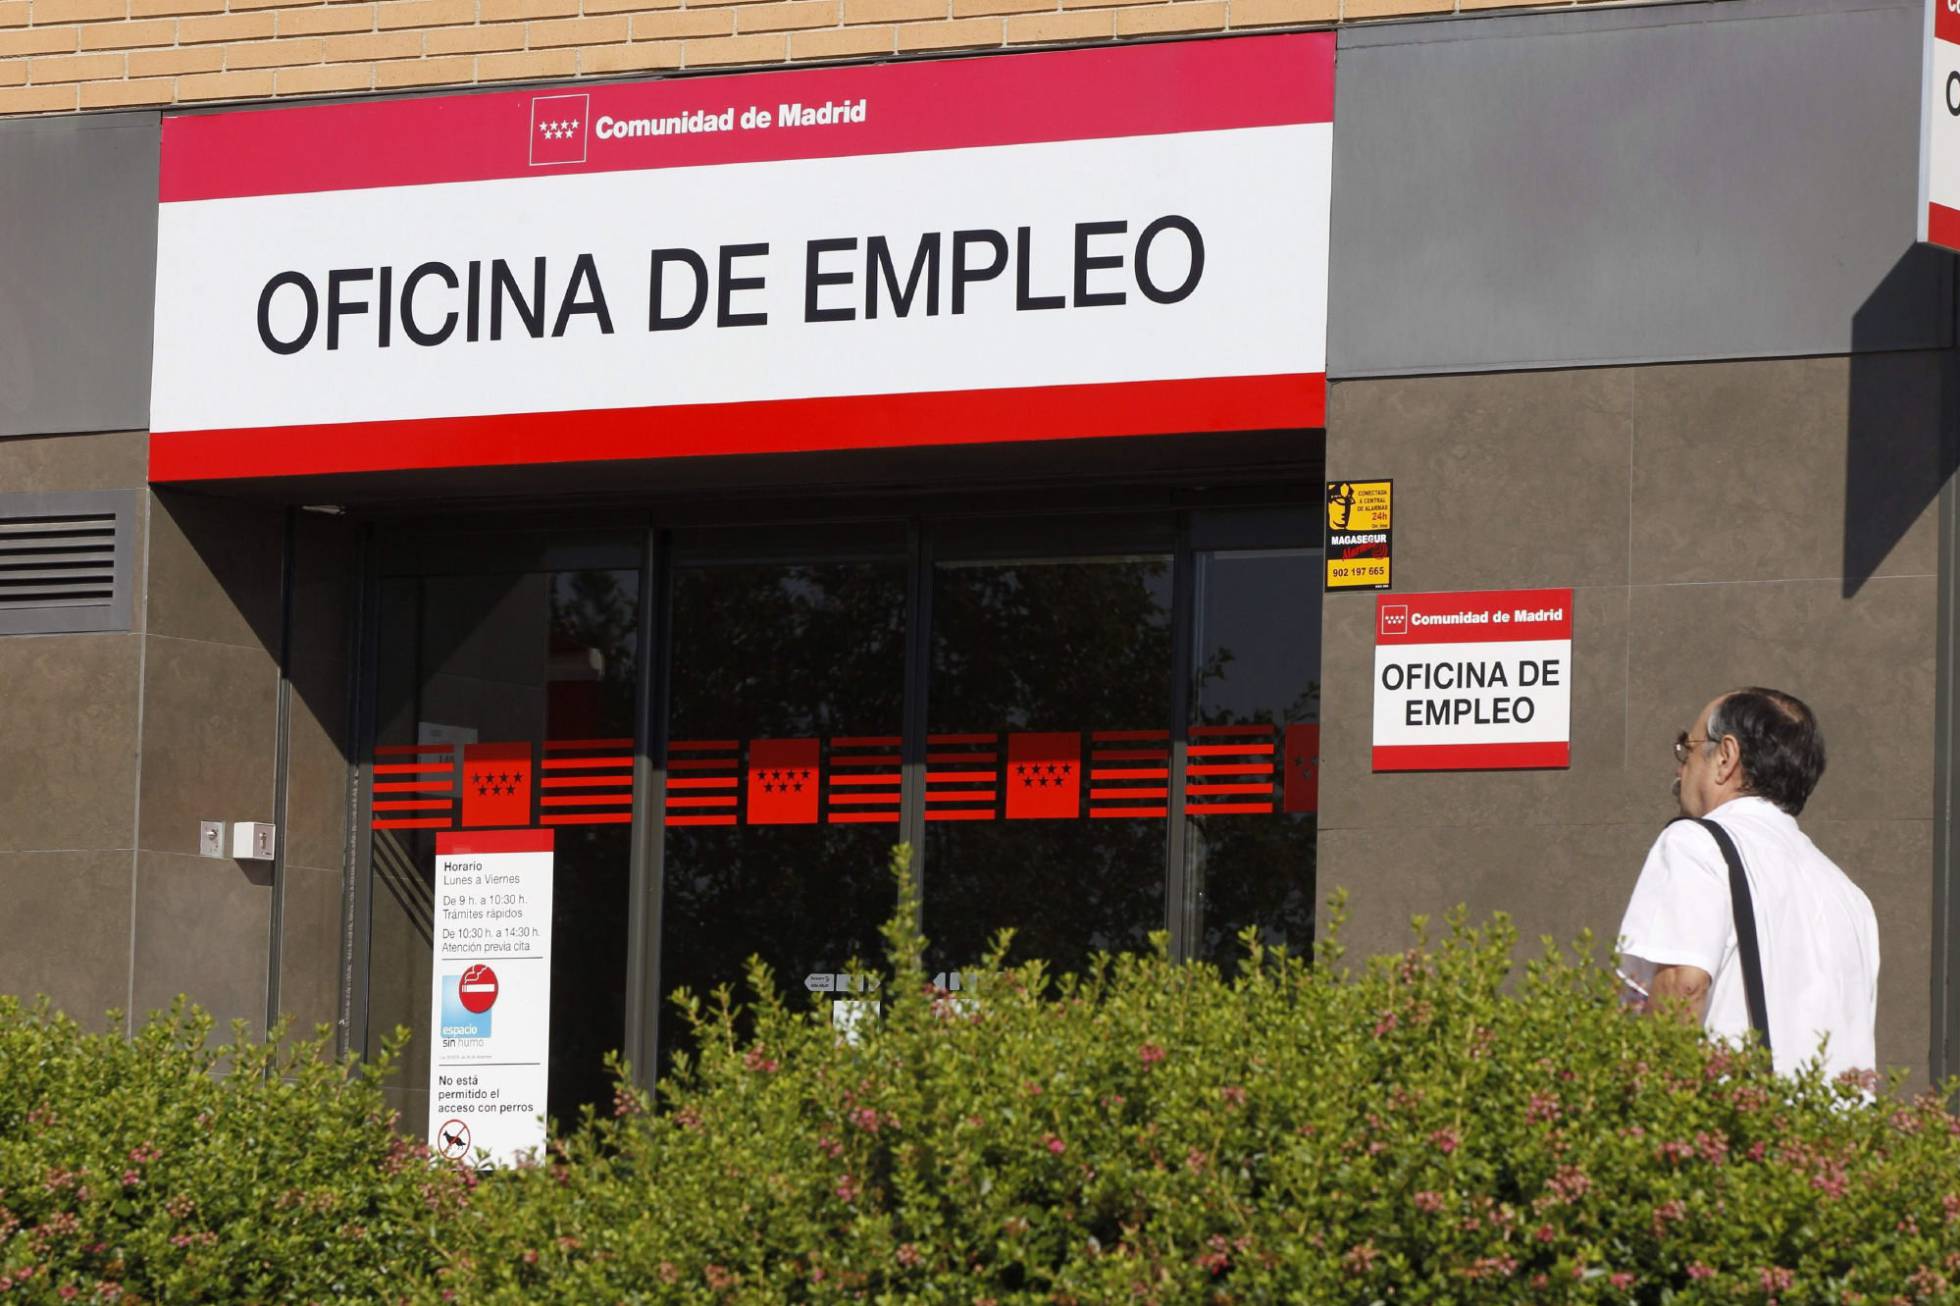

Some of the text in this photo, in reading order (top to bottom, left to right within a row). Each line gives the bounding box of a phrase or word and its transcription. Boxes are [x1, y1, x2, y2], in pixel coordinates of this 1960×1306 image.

[595, 99, 867, 140] Comunidad de Madrid
[256, 214, 1205, 356] OFICINA DE EMPLEO
[1331, 534, 1387, 545] MAGASEGUR
[1333, 568, 1349, 577] 902
[1352, 567, 1366, 576] 197
[1411, 608, 1563, 625] Comunidad de Madrid
[1381, 659, 1560, 690] OFICINA DE
[1405, 696, 1535, 726] EMPLEO
[444, 861, 482, 872] Horario
[443, 875, 473, 885] Lunes
[485, 874, 520, 884] Viernes
[443, 896, 456, 906] De
[459, 895, 465, 905] 9
[480, 897, 486, 905] a
[490, 894, 516, 904] 10:30
[519, 894, 528, 904] h.
[443, 907, 523, 920] Trámites rápidos
[442, 928, 455, 939] De
[458, 928, 483, 938] 10:30
[496, 930, 502, 938] a
[505, 927, 530, 937] 14:30
[442, 941, 530, 953] Atención previa cita
[442, 1023, 478, 1036] espacio
[442, 1037, 485, 1048] sin humo
[438, 1074, 478, 1085] No está
[438, 1088, 500, 1101] permitido el
[438, 1103, 534, 1114] acceso con perros
